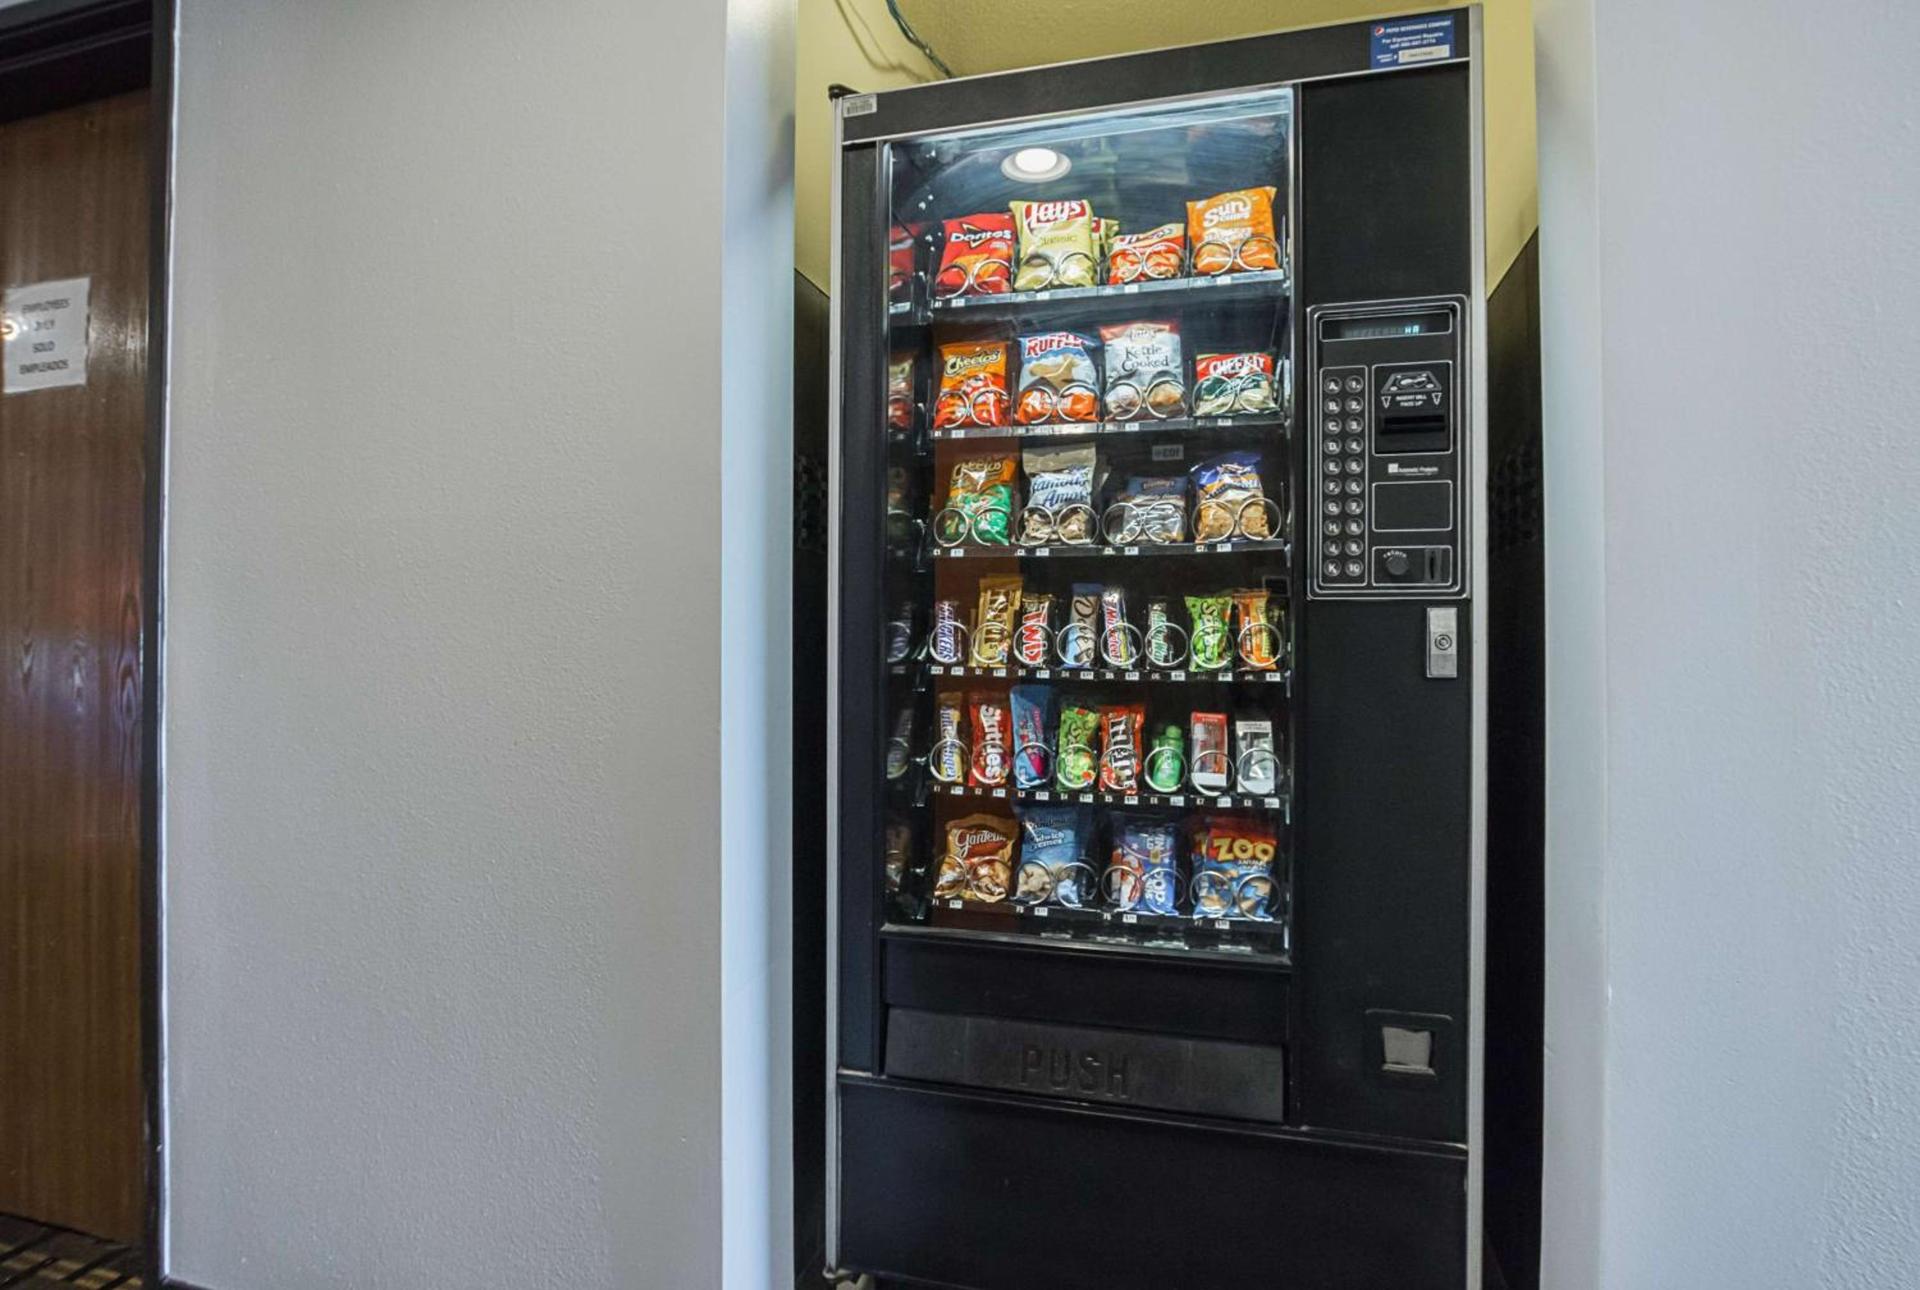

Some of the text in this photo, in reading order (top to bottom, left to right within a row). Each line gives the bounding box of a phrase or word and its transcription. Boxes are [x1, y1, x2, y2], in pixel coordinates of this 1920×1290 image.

[950, 230, 1012, 243] Doritos
[944, 349, 1001, 377] Cheetos
[1121, 355, 1169, 372] Cooked
[1213, 837, 1275, 863] ZOO
[1019, 1048, 1130, 1099] PUSH
